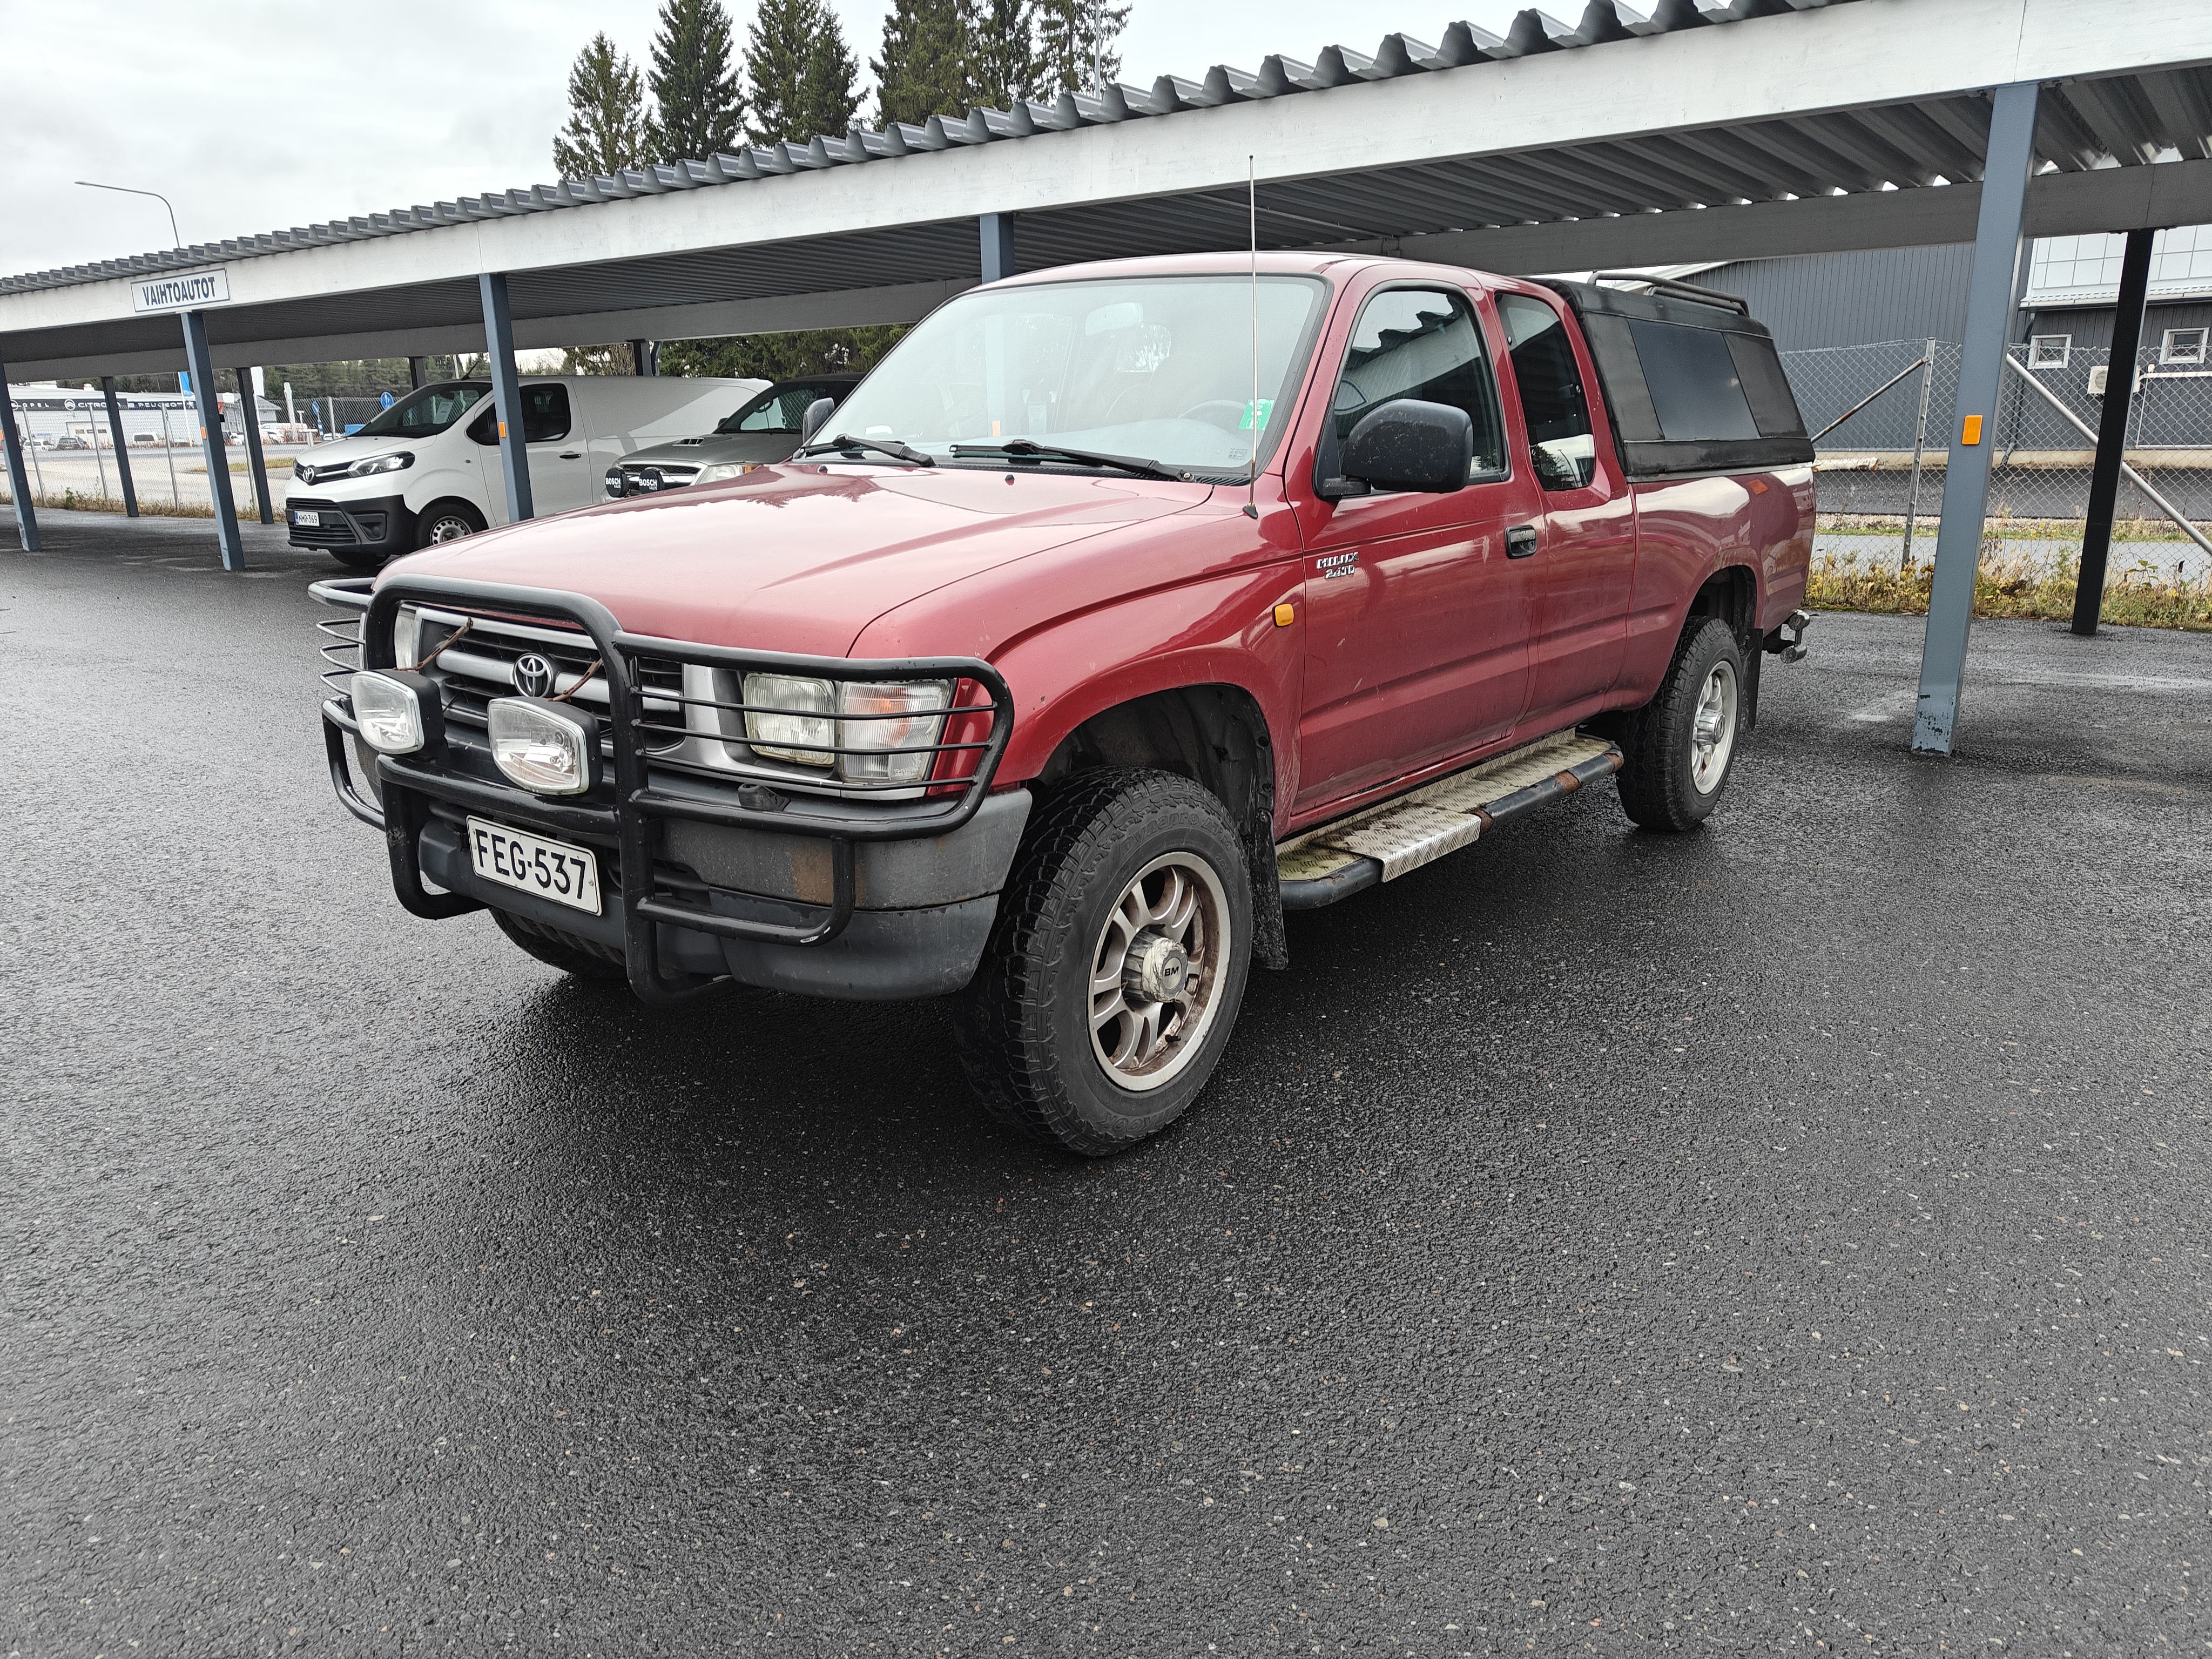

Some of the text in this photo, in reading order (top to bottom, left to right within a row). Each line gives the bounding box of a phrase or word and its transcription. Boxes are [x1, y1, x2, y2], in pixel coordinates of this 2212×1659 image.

[142, 276, 215, 306] VAIHTOAUTOT
[1317, 551, 1359, 569] HILUX
[475, 828, 586, 899] FEG-537
